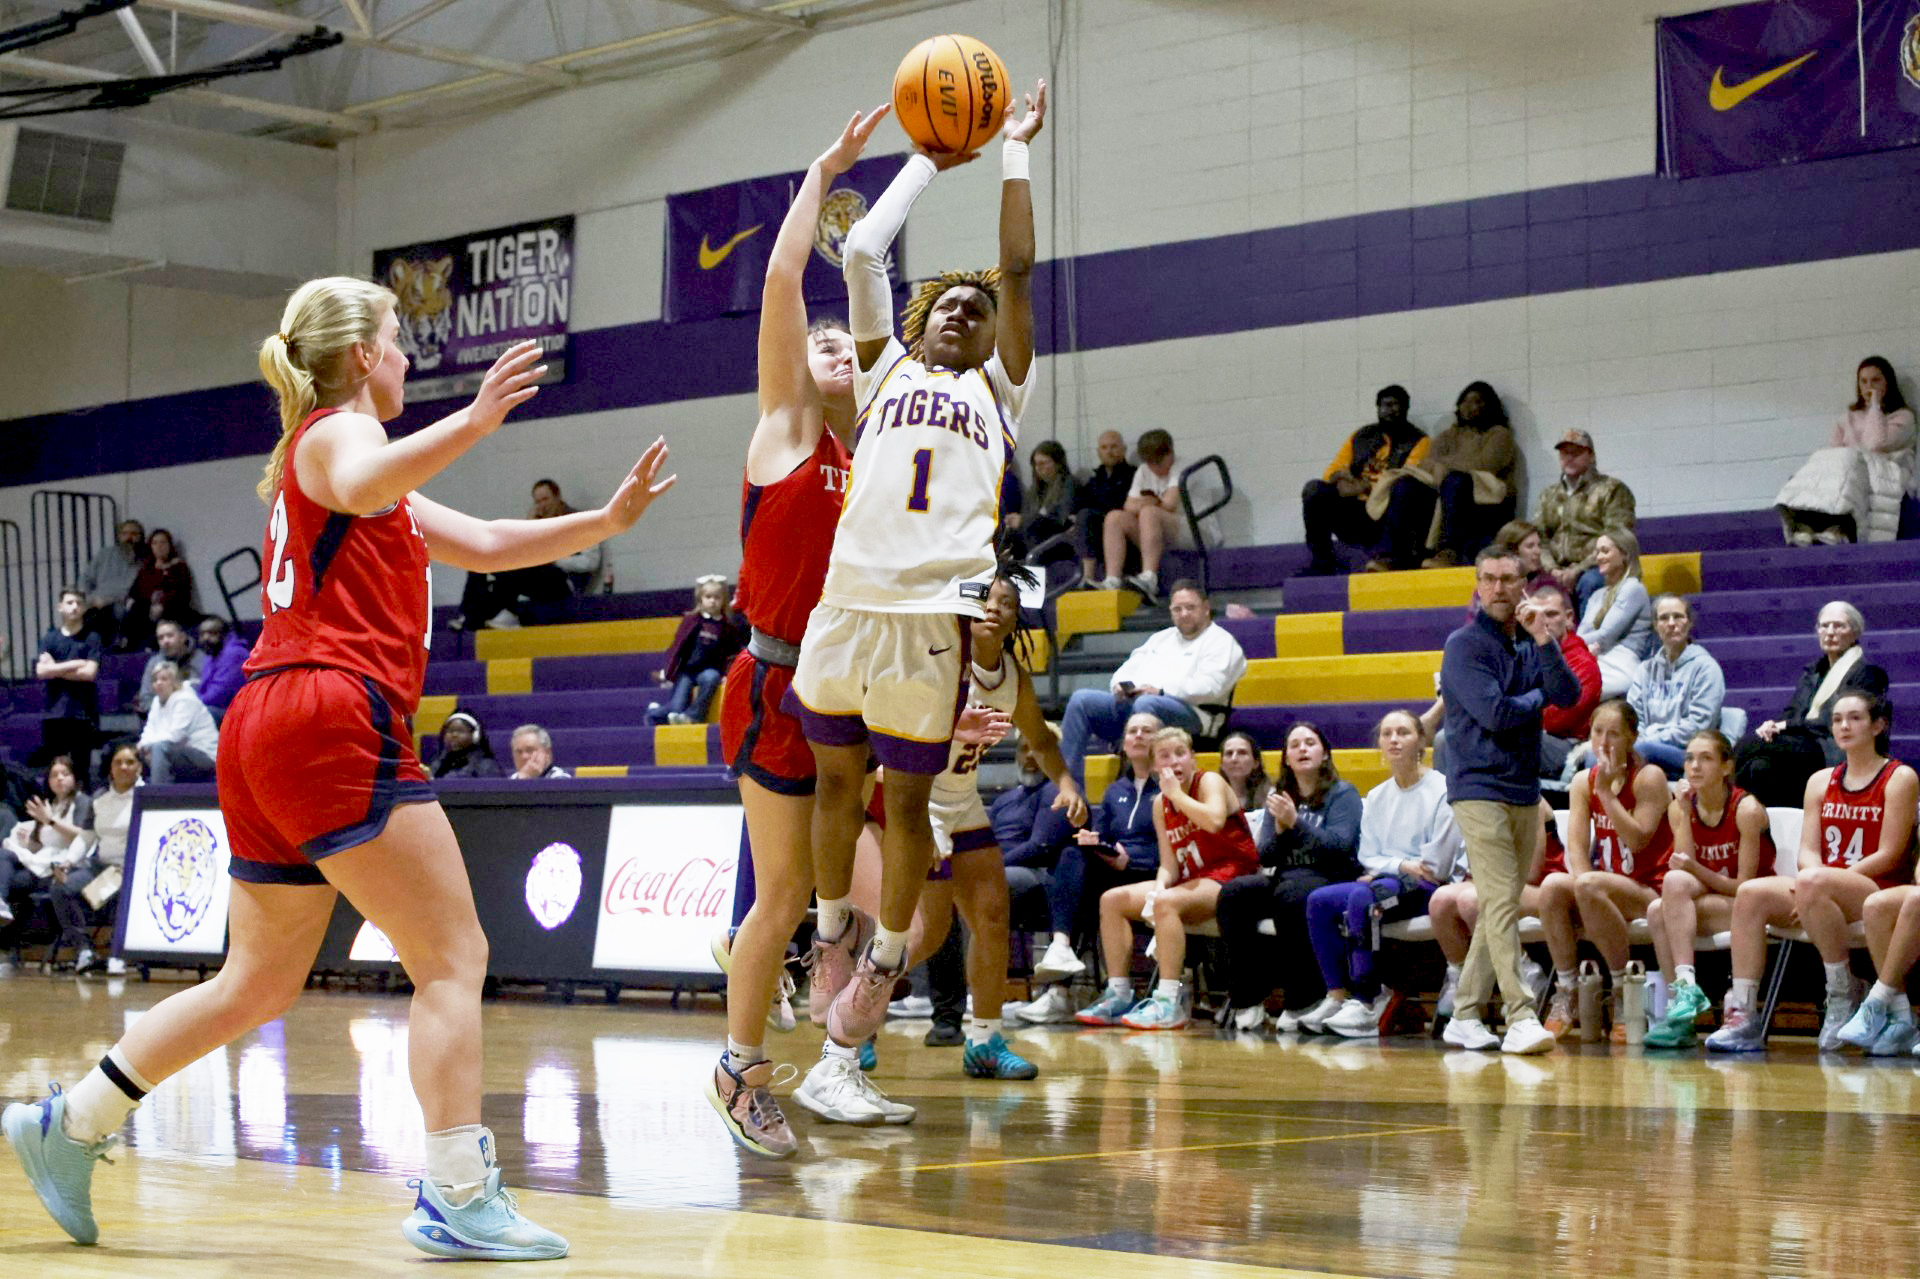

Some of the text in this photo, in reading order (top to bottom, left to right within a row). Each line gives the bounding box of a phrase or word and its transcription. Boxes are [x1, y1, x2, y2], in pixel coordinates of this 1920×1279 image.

[972, 51, 998, 130] Wilson
[467, 228, 561, 286] TIGER
[456, 278, 569, 339] NATION
[876, 389, 989, 450] TIGERS
[906, 448, 935, 514] 1
[262, 490, 296, 615] 2
[1825, 825, 1864, 866] 34
